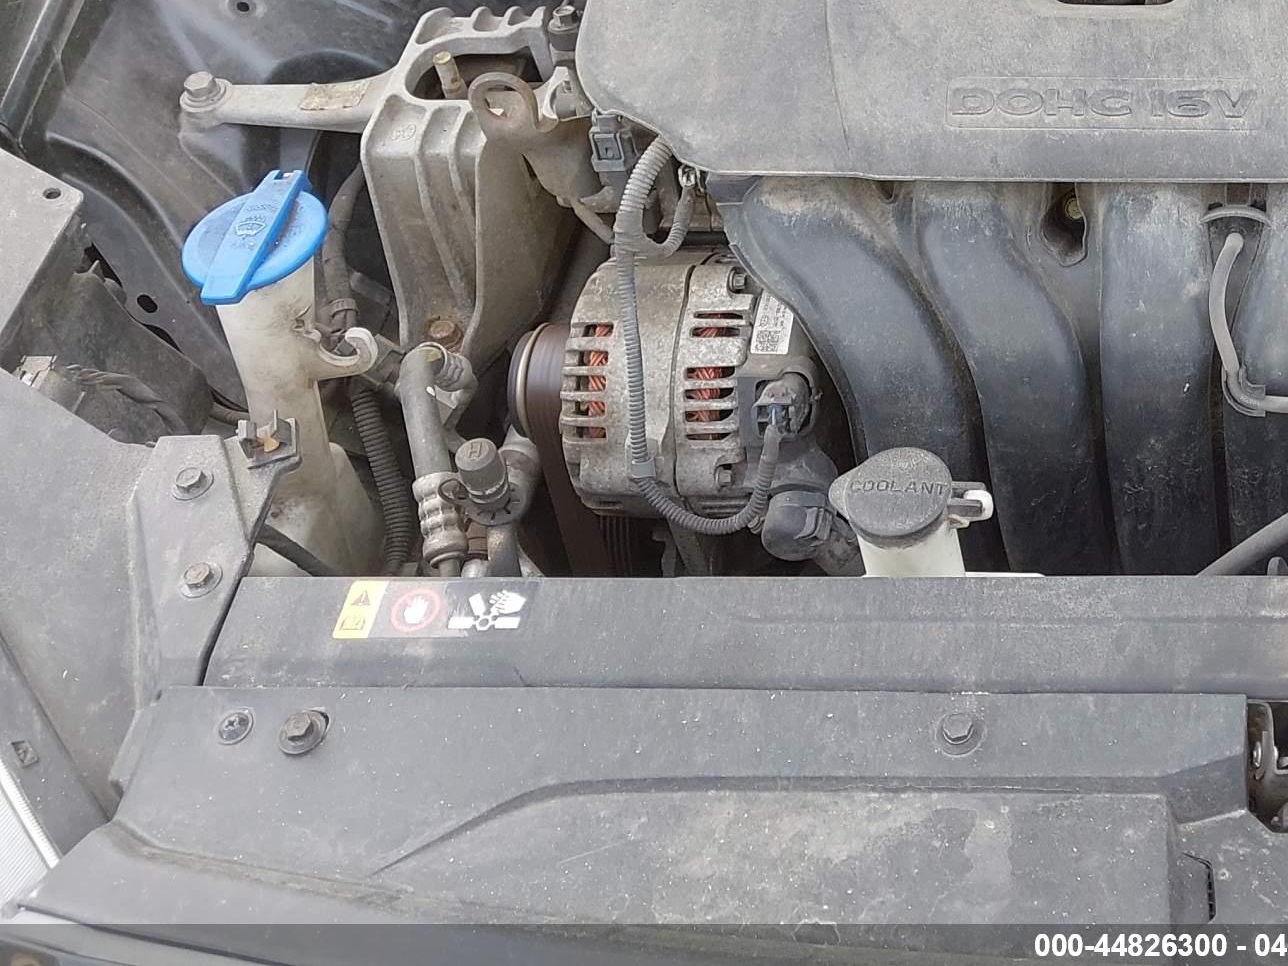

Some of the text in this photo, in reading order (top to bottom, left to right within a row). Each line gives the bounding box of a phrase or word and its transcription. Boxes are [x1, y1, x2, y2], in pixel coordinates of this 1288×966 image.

[951, 87, 1257, 119] DOHC 16V
[850, 479, 949, 496] COOLANT
